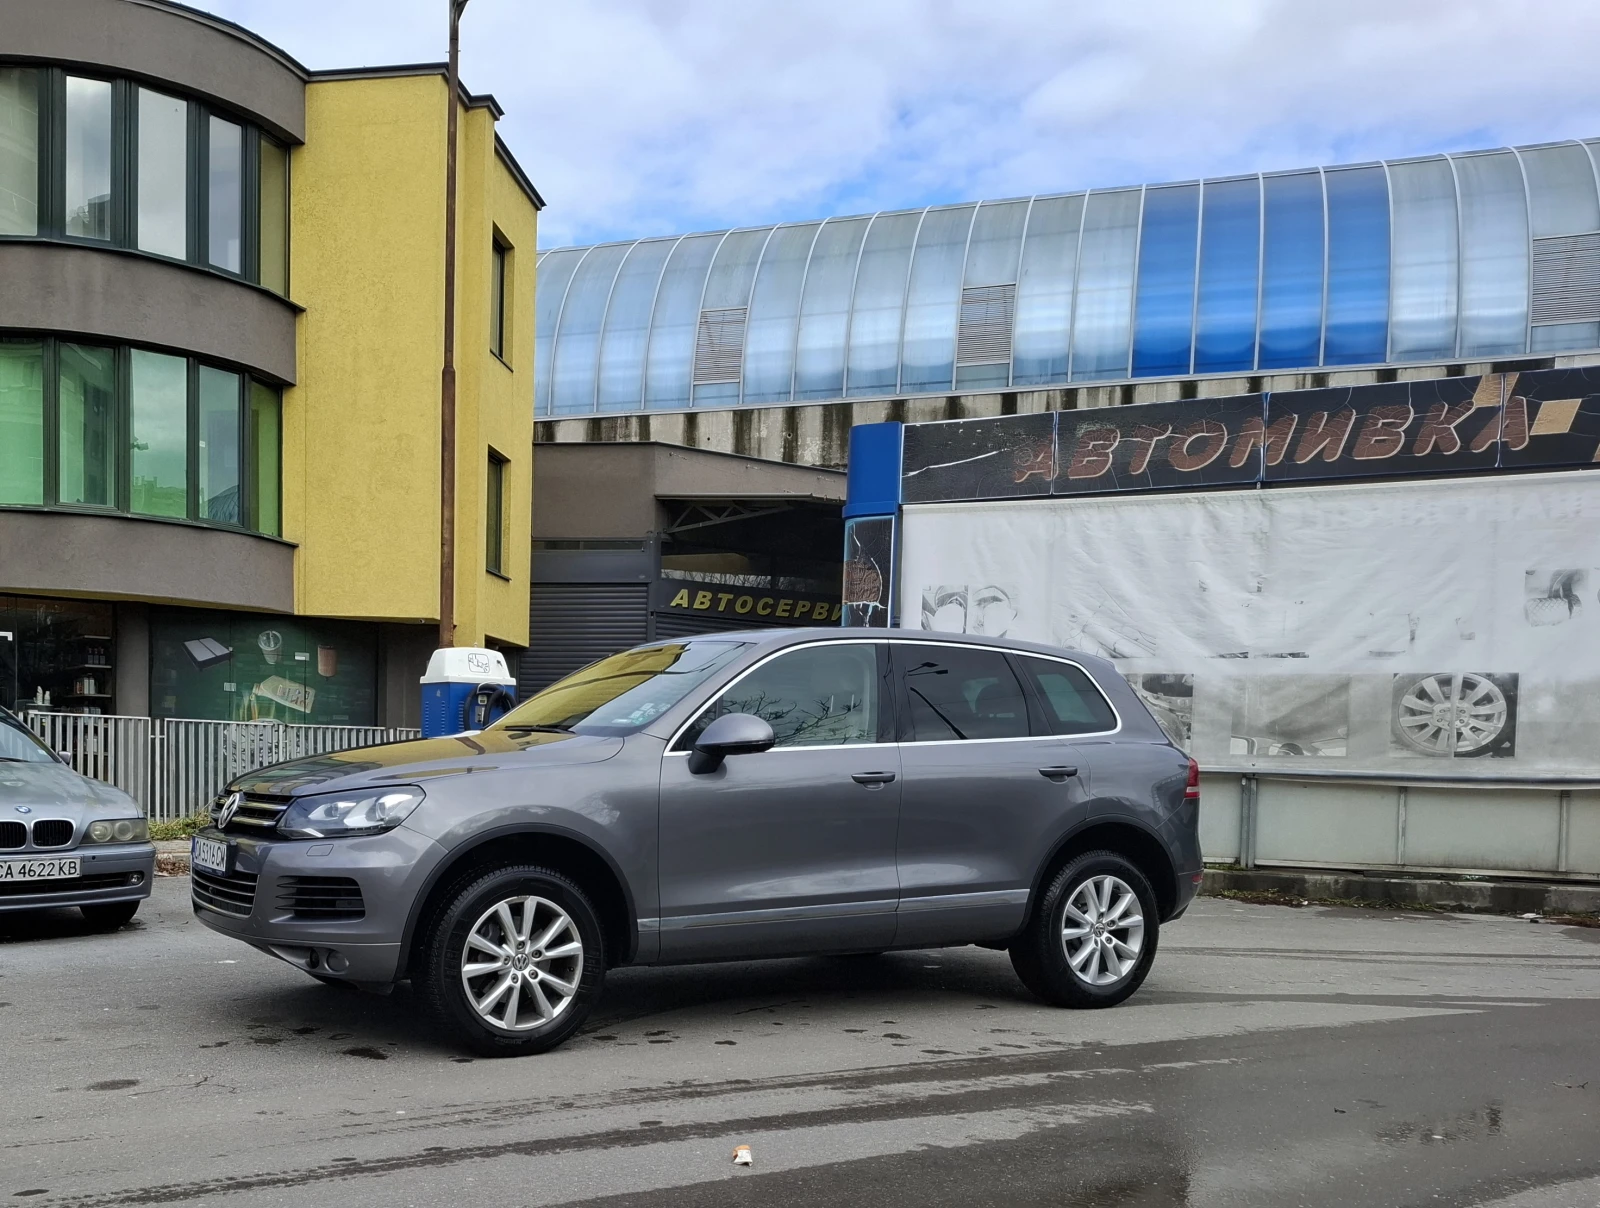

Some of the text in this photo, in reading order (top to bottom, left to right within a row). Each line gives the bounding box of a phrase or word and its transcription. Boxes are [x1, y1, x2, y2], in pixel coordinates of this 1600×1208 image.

[1014, 395, 1529, 483] АВТОМИВКА
[18, 862, 55, 878] 4622
[58, 860, 77, 876] KB
